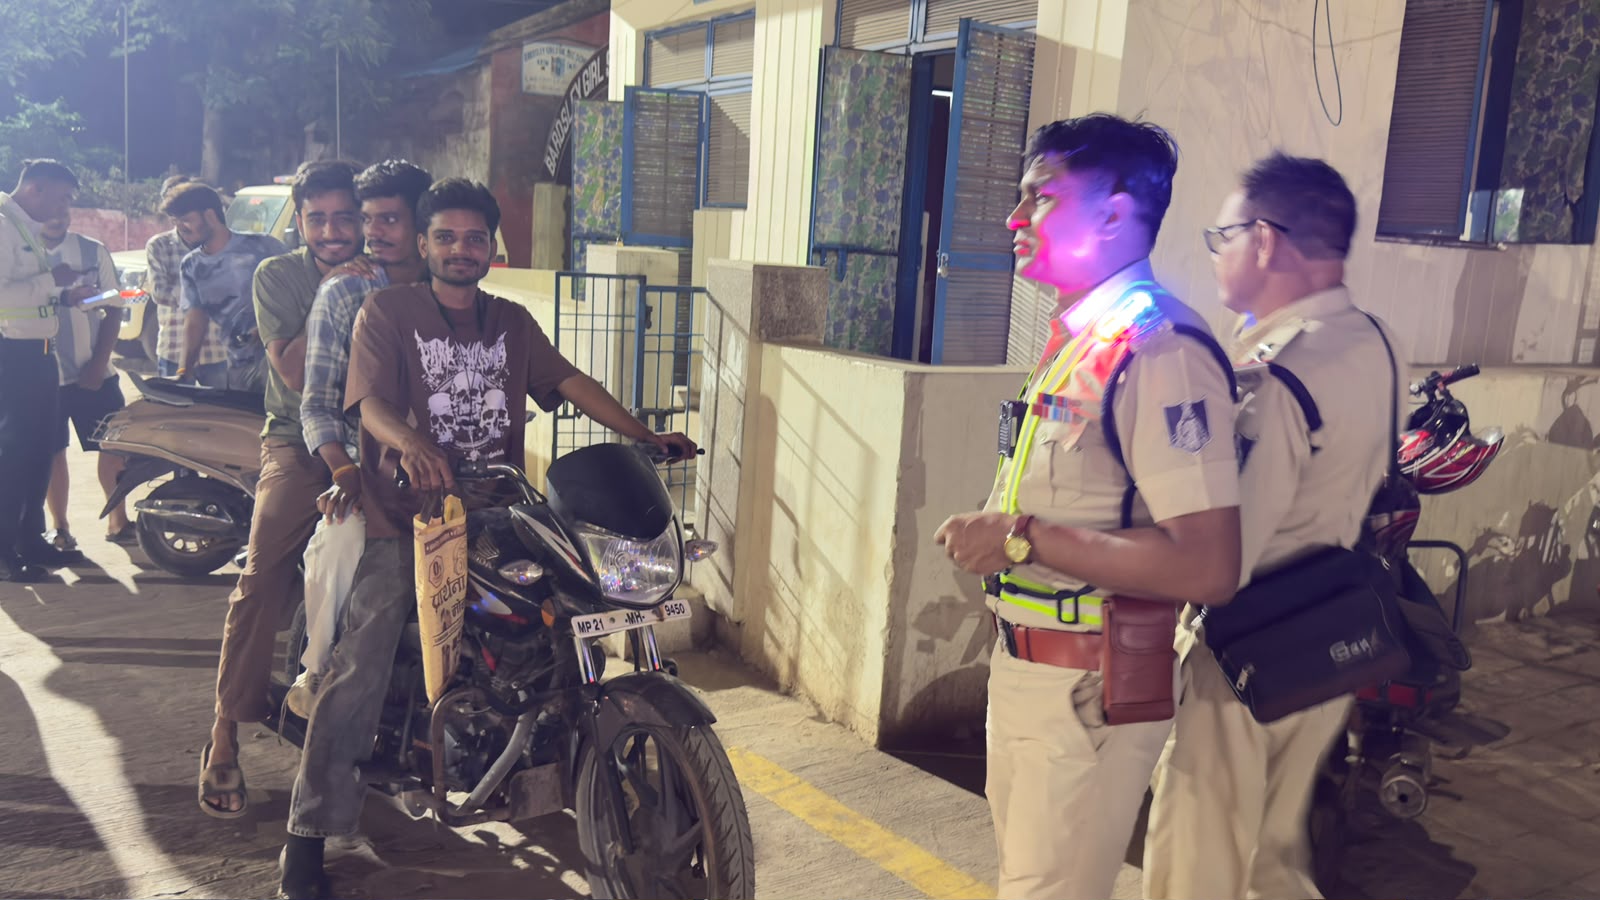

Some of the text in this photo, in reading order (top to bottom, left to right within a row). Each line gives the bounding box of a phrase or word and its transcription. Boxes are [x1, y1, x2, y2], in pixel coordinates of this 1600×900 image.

[577, 621, 592, 634] MP
[594, 618, 605, 632] 21
[664, 603, 686, 616] 9450
